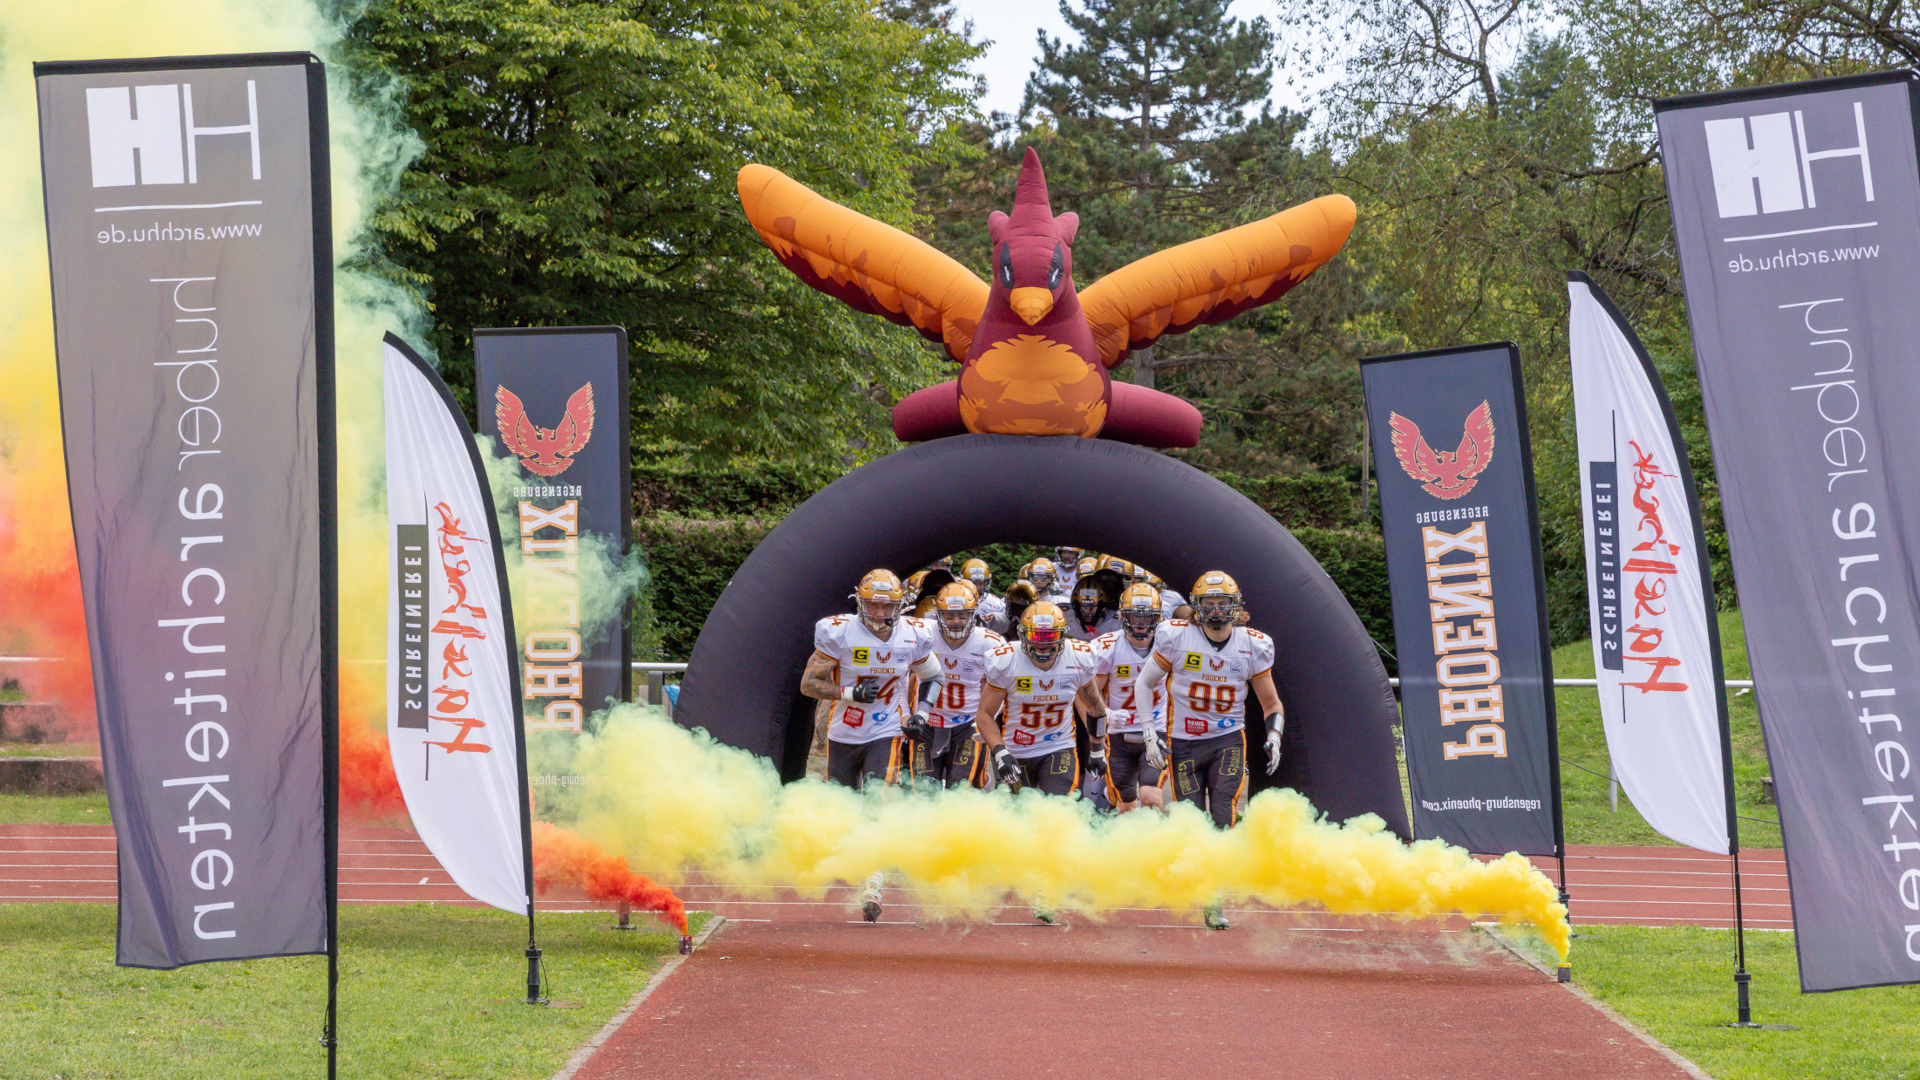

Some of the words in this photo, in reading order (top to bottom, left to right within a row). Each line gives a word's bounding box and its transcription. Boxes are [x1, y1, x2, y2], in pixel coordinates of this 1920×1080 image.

[1097, 633, 1117, 650] 24
[1201, 673, 1228, 683] PHOENIX
[1187, 681, 1237, 714] 99
[1020, 701, 1069, 729] 55
